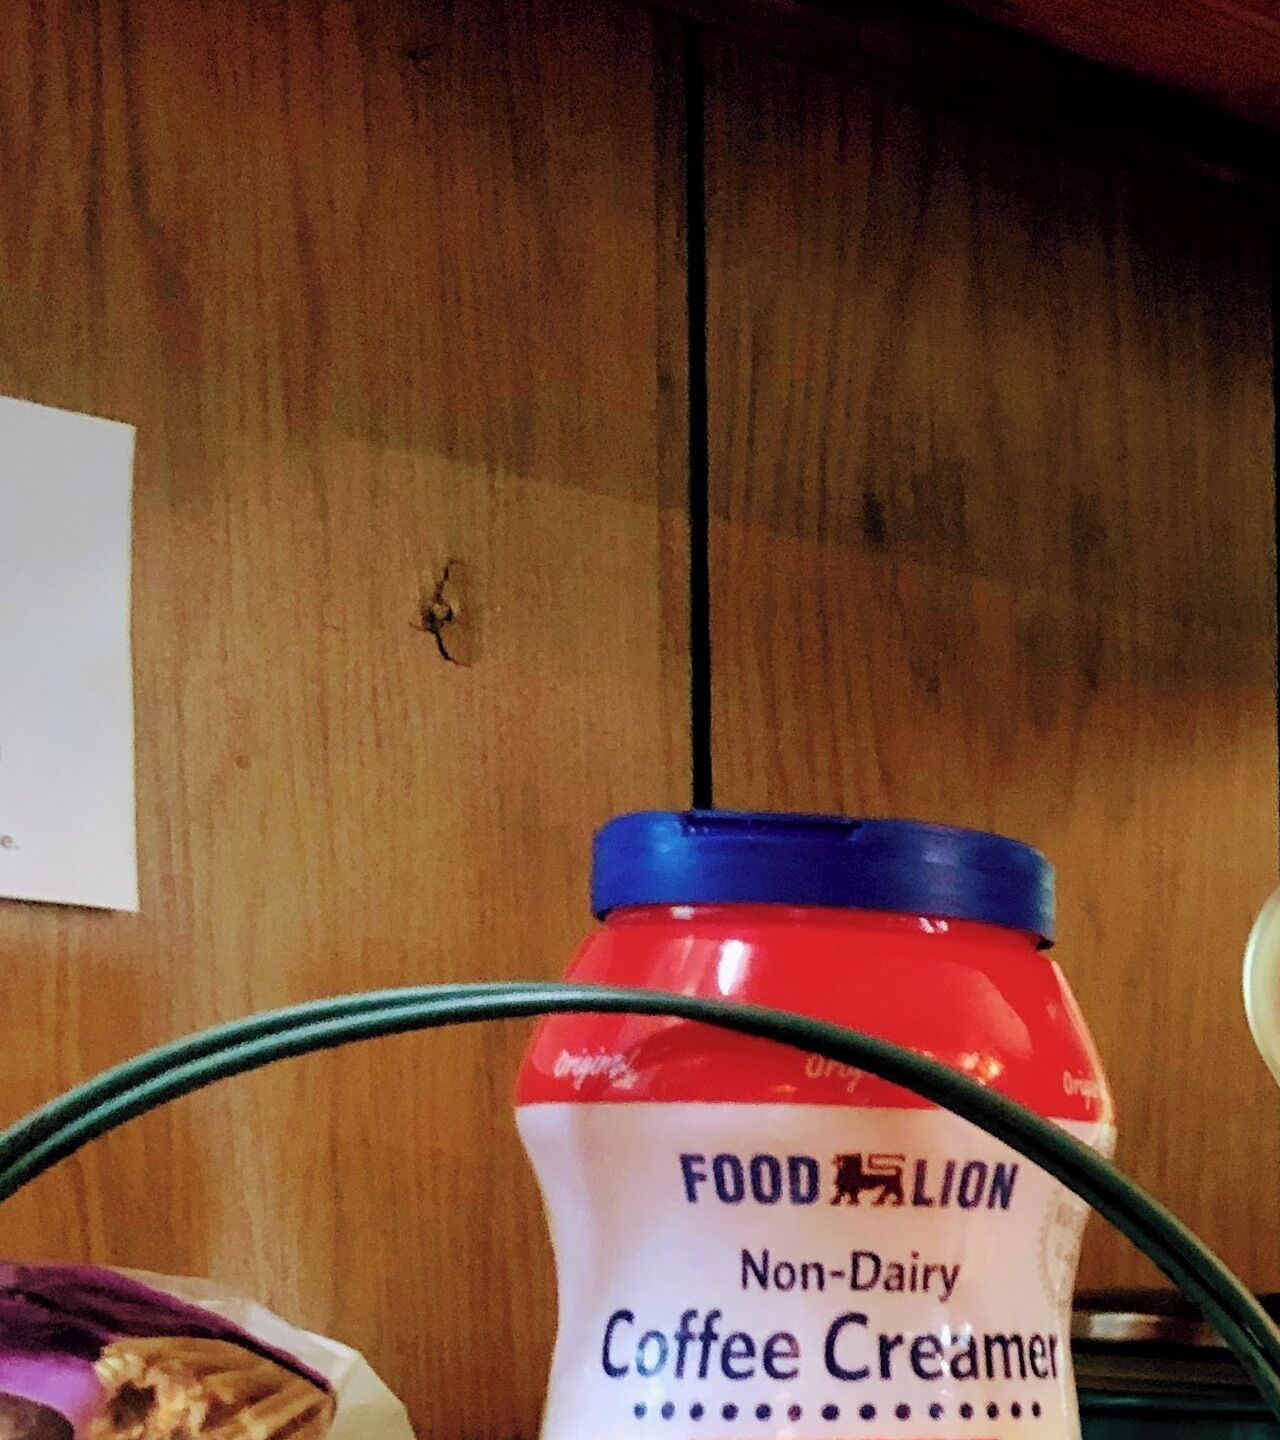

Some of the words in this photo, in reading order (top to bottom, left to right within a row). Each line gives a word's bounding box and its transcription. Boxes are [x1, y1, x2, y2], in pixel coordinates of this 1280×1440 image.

[679, 1152, 821, 1205] FOOD
[912, 1159, 1021, 1210] LION
[739, 1248, 962, 1302] Non-Dairy
[600, 1308, 801, 1381] Coffee
[823, 1311, 1059, 1383] Creamer
